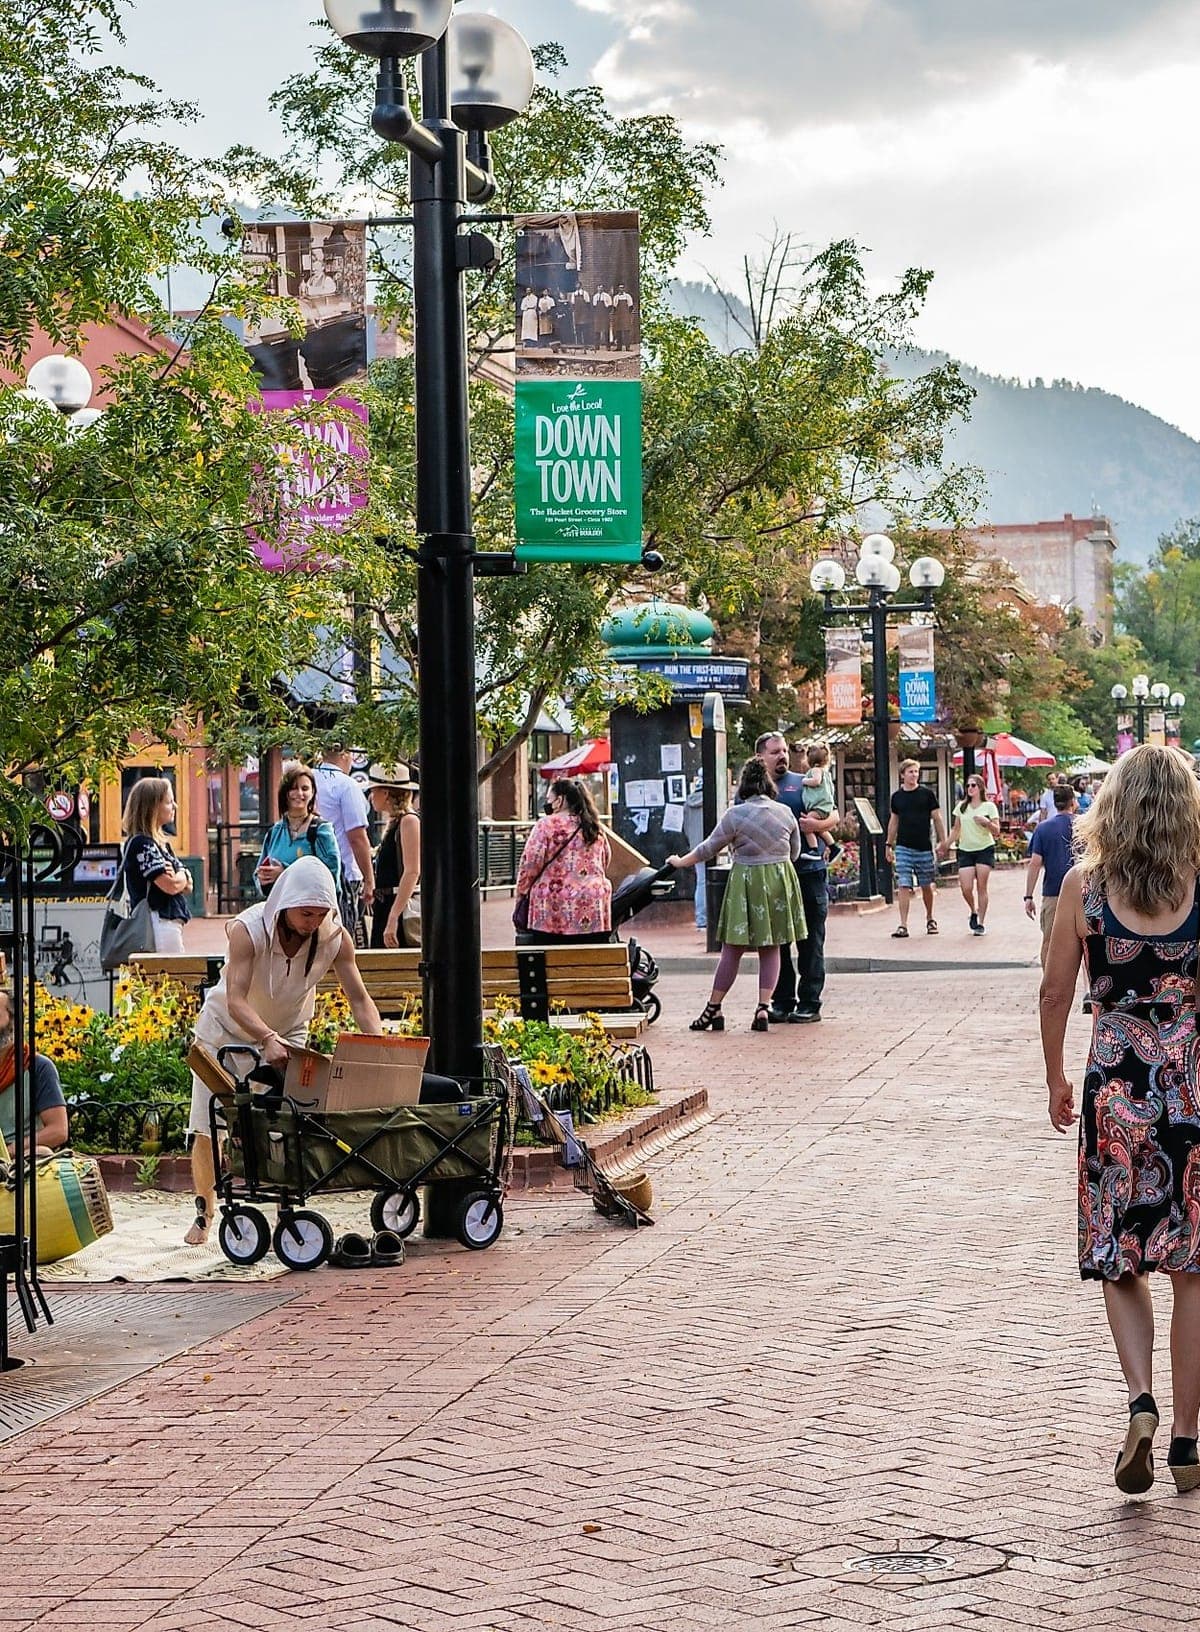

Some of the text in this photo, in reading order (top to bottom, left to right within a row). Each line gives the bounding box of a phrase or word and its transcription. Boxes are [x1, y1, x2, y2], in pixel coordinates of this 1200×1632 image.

[552, 398, 603, 414] Love the Local
[536, 415, 621, 457] DOWN
[536, 460, 621, 503] TOWN
[529, 507, 628, 518] The Racket Grocery Store
[664, 665, 678, 675] RUN
[679, 665, 692, 675] THE
[693, 665, 723, 675] FIRST-EVER
[832, 684, 857, 696] DOWN
[905, 681, 929, 693] DOWN
[833, 696, 857, 708] TOWN
[906, 694, 930, 706] TOWN
[66, 896, 109, 904] LANDFIL
